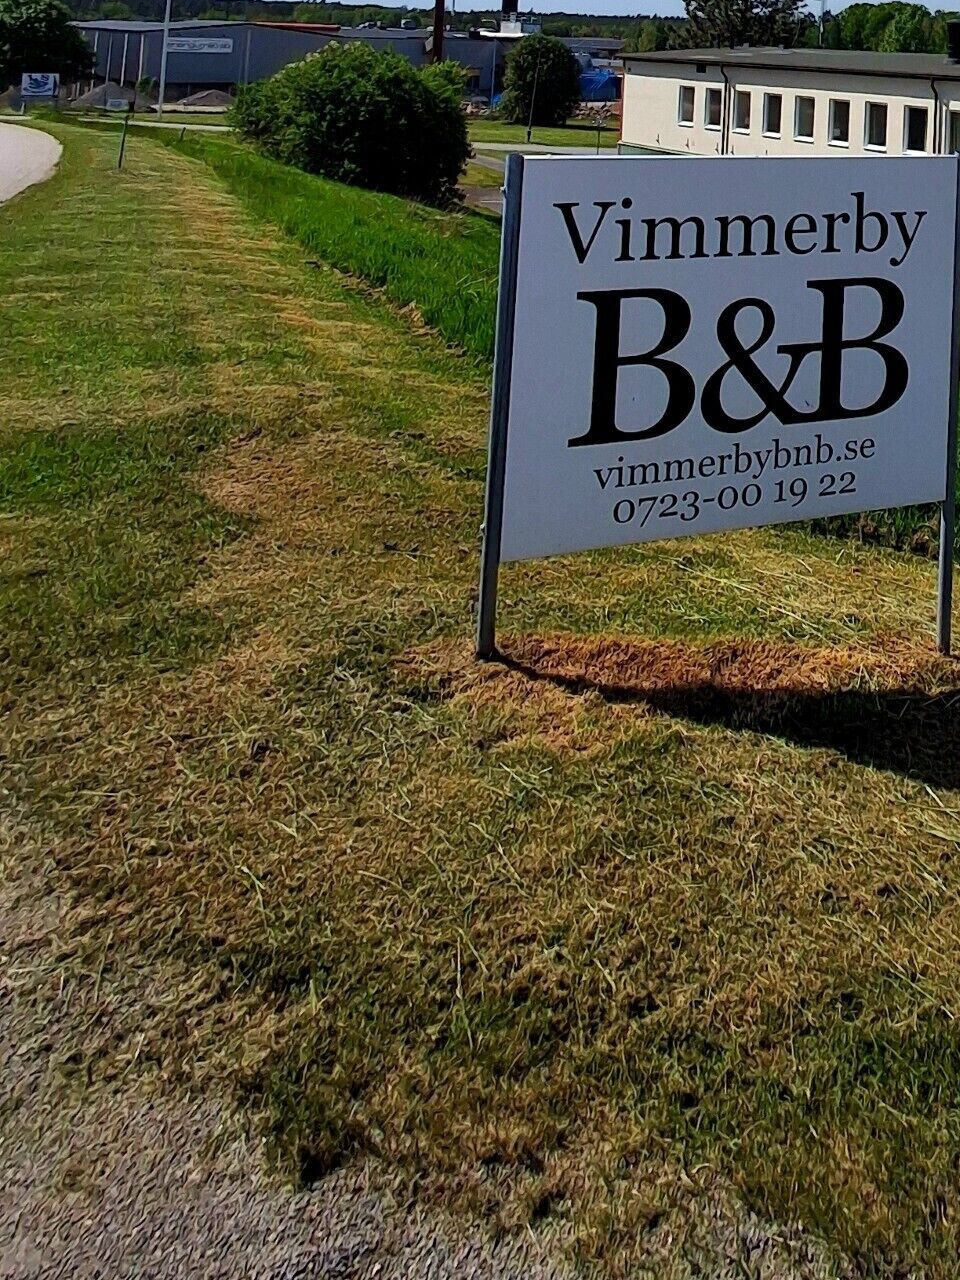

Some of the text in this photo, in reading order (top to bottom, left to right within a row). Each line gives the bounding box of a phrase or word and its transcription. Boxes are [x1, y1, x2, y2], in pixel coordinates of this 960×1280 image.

[553, 192, 927, 266] Vimmerby
[567, 277, 909, 447] B&B
[593, 435, 875, 489] vimmerbybnb.se
[613, 471, 856, 527] 0723-00 19 22
